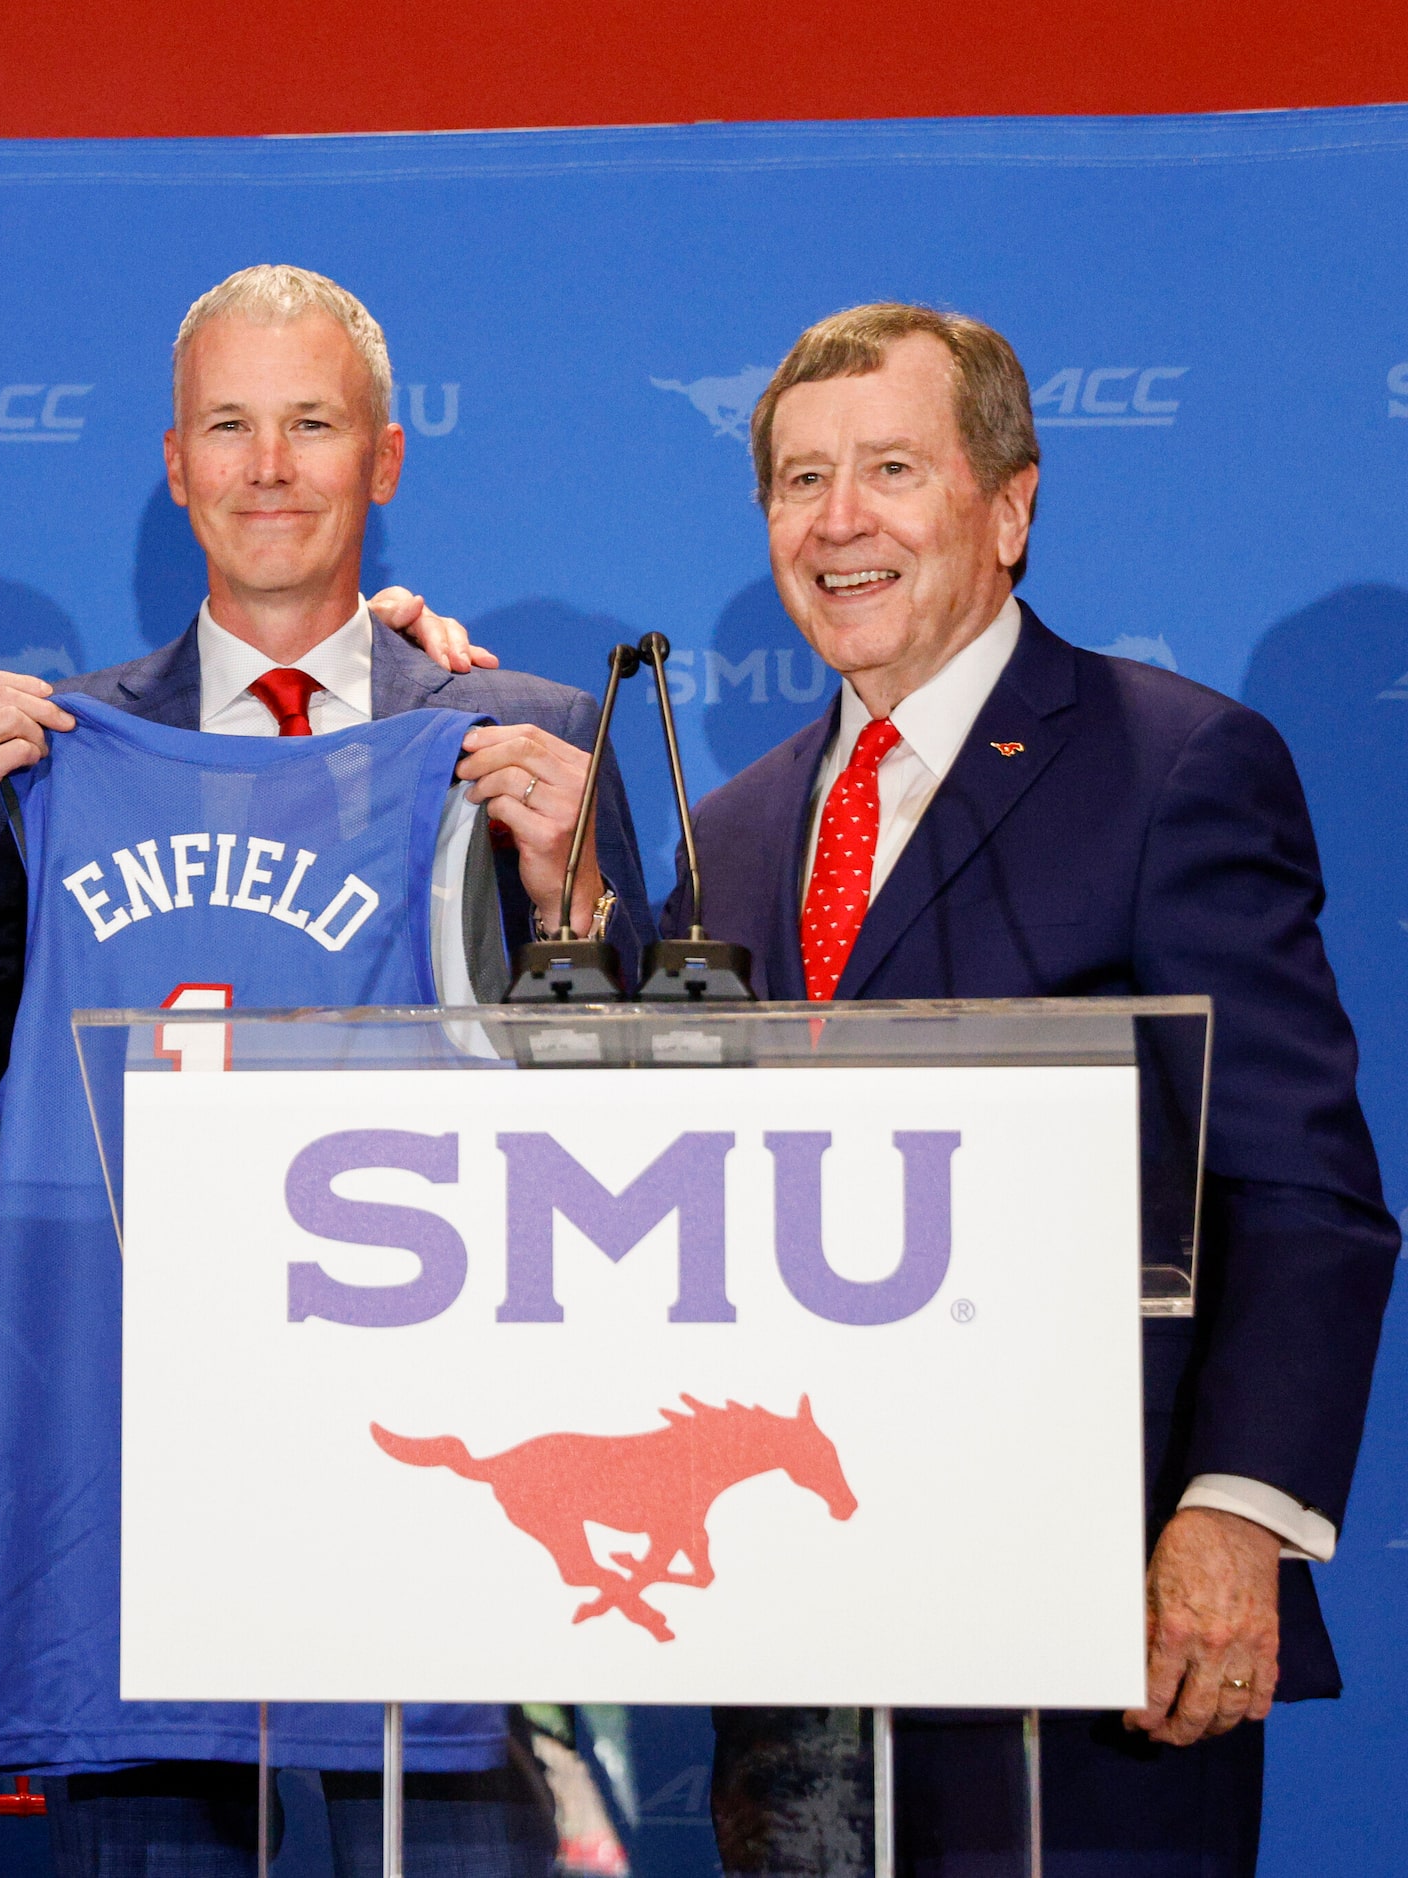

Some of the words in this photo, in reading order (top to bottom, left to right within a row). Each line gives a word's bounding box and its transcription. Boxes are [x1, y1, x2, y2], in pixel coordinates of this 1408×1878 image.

[1031, 367, 1190, 414] ACC
[645, 648, 827, 704] SMU
[62, 833, 379, 951] ENFIELD
